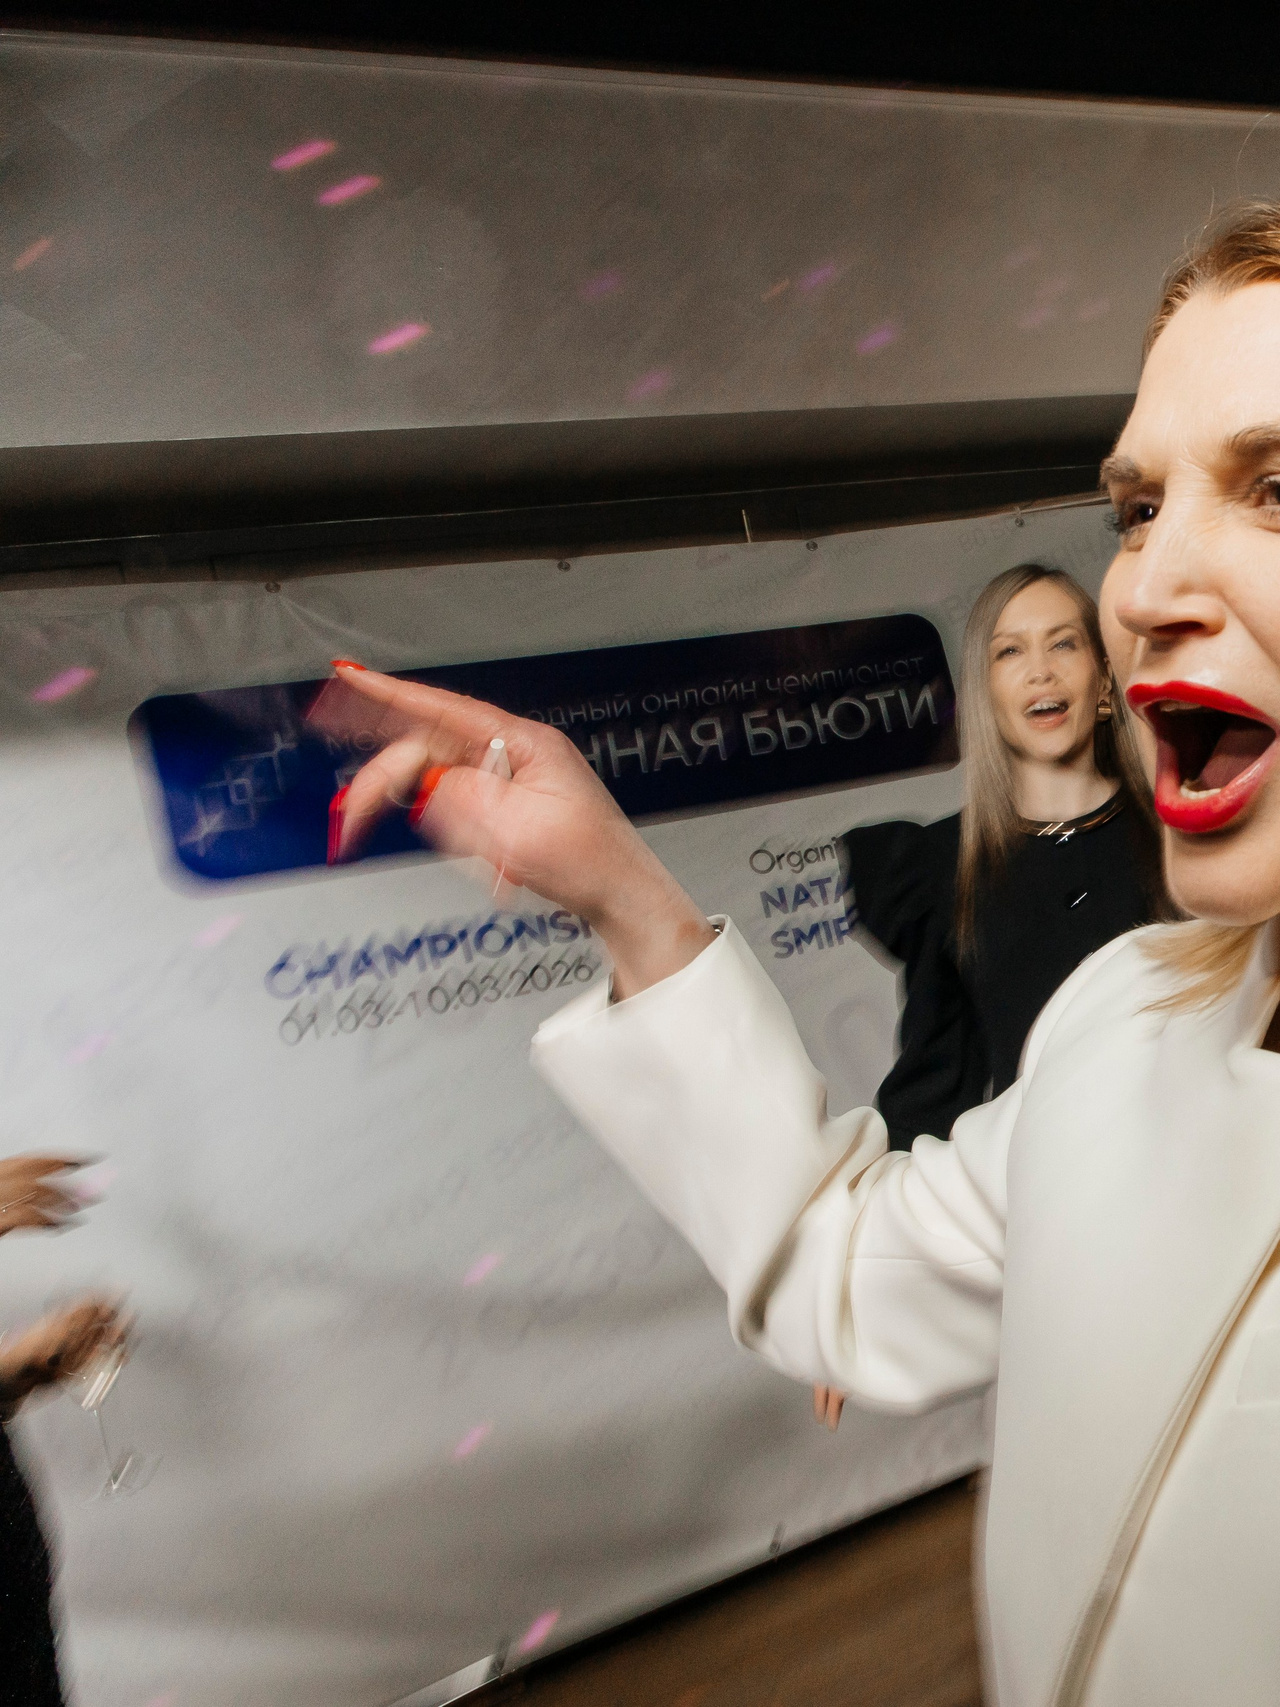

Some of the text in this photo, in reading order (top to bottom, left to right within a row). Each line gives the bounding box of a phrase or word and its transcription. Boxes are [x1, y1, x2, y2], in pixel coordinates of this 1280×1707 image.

[641, 678, 757, 714] онлайн
[765, 655, 924, 692] чемпионат
[741, 684, 939, 757] БЬЮТИ
[264, 908, 592, 1000] CHAMPIONS
